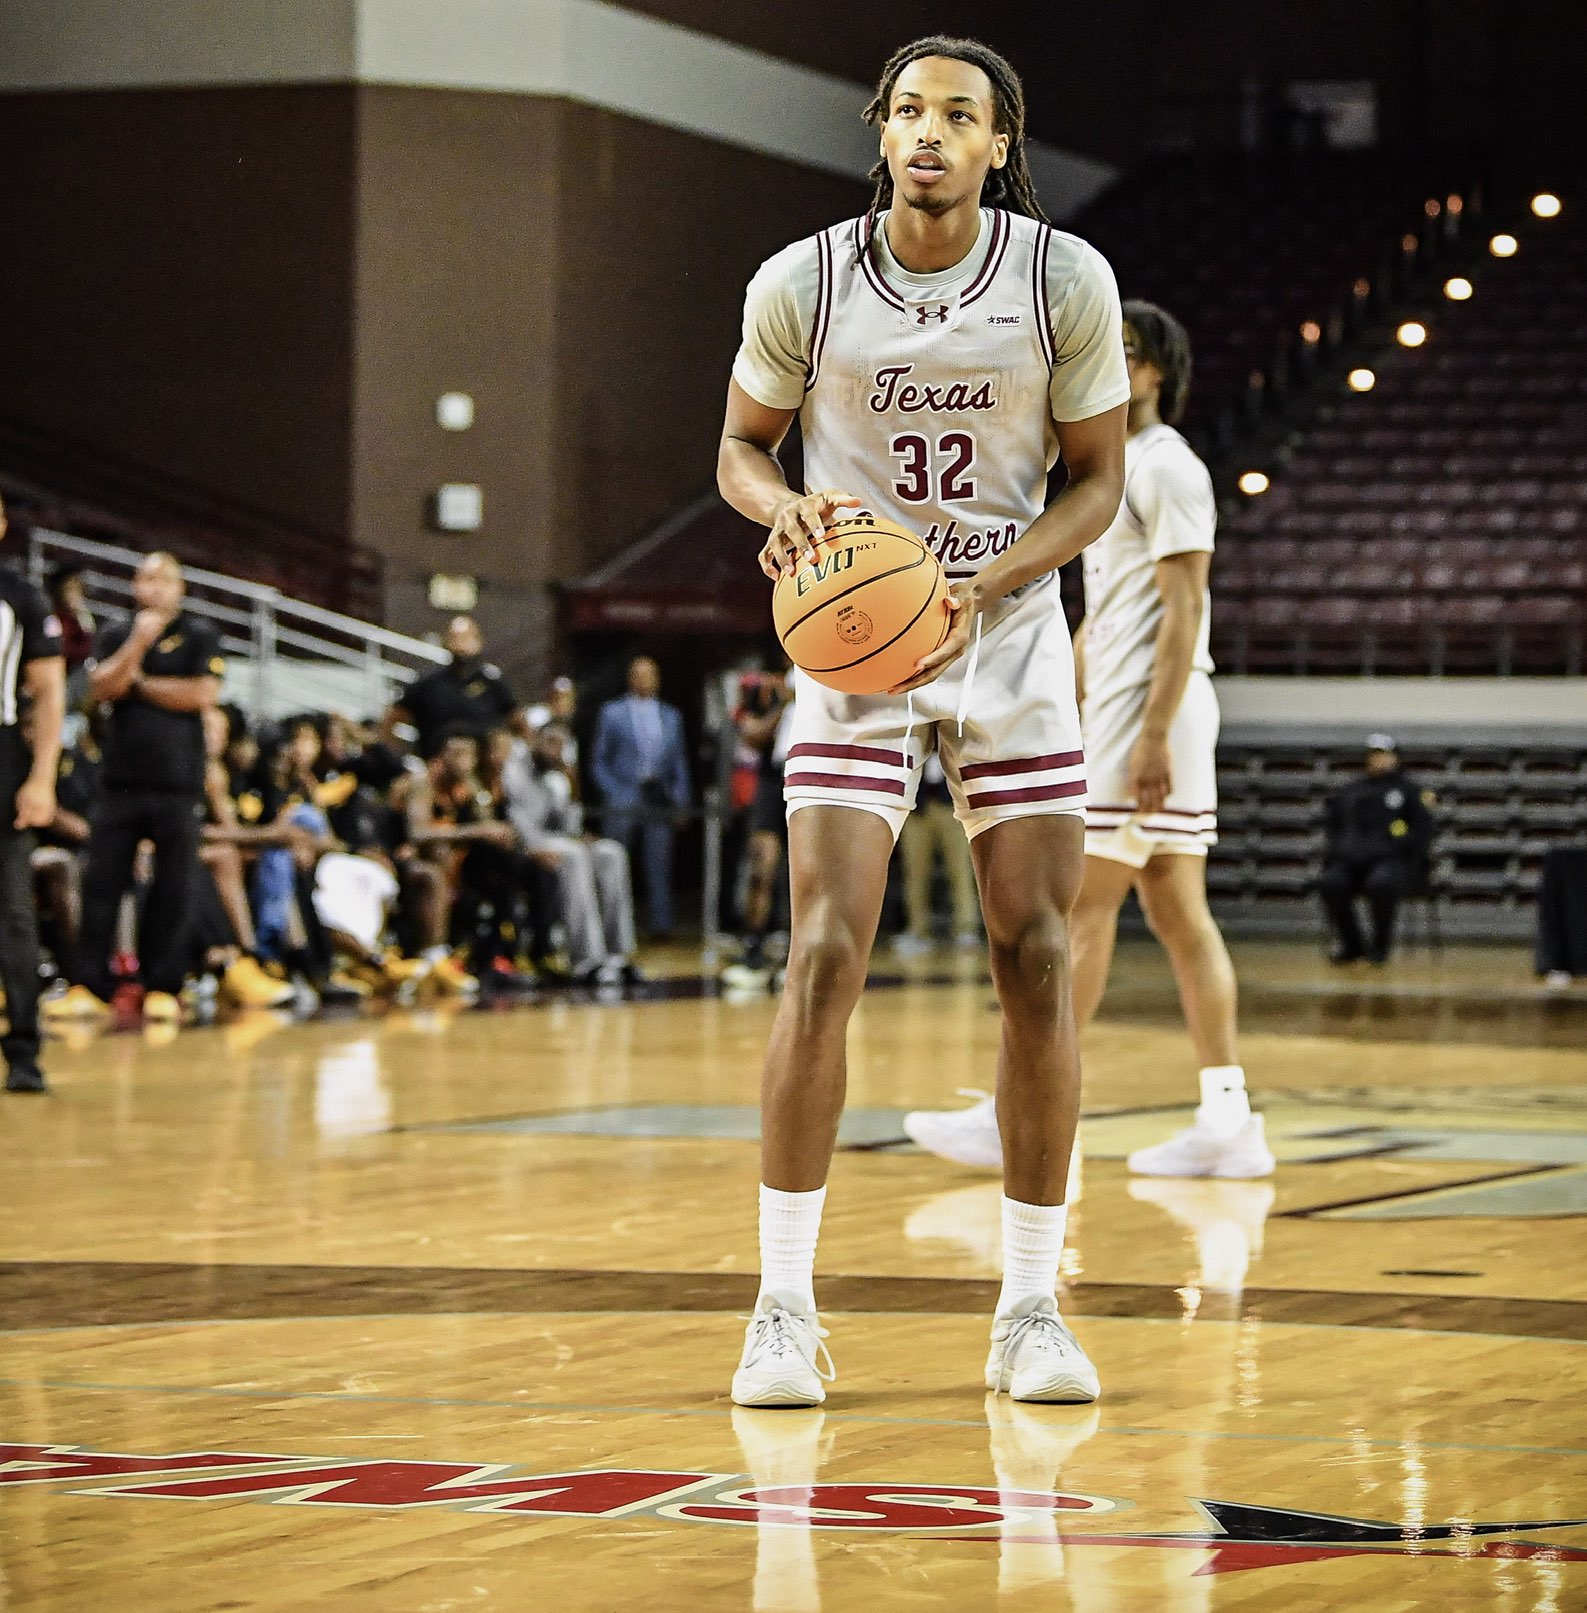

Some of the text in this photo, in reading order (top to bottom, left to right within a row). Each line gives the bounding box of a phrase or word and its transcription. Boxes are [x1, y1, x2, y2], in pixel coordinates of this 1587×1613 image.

[995, 316, 1020, 325] SWAC
[869, 364, 996, 413] Texas
[891, 432, 976, 504] 32
[856, 542, 878, 552] NXT
[924, 520, 1017, 563] thern
[0, 1443, 1116, 1530] SWA
